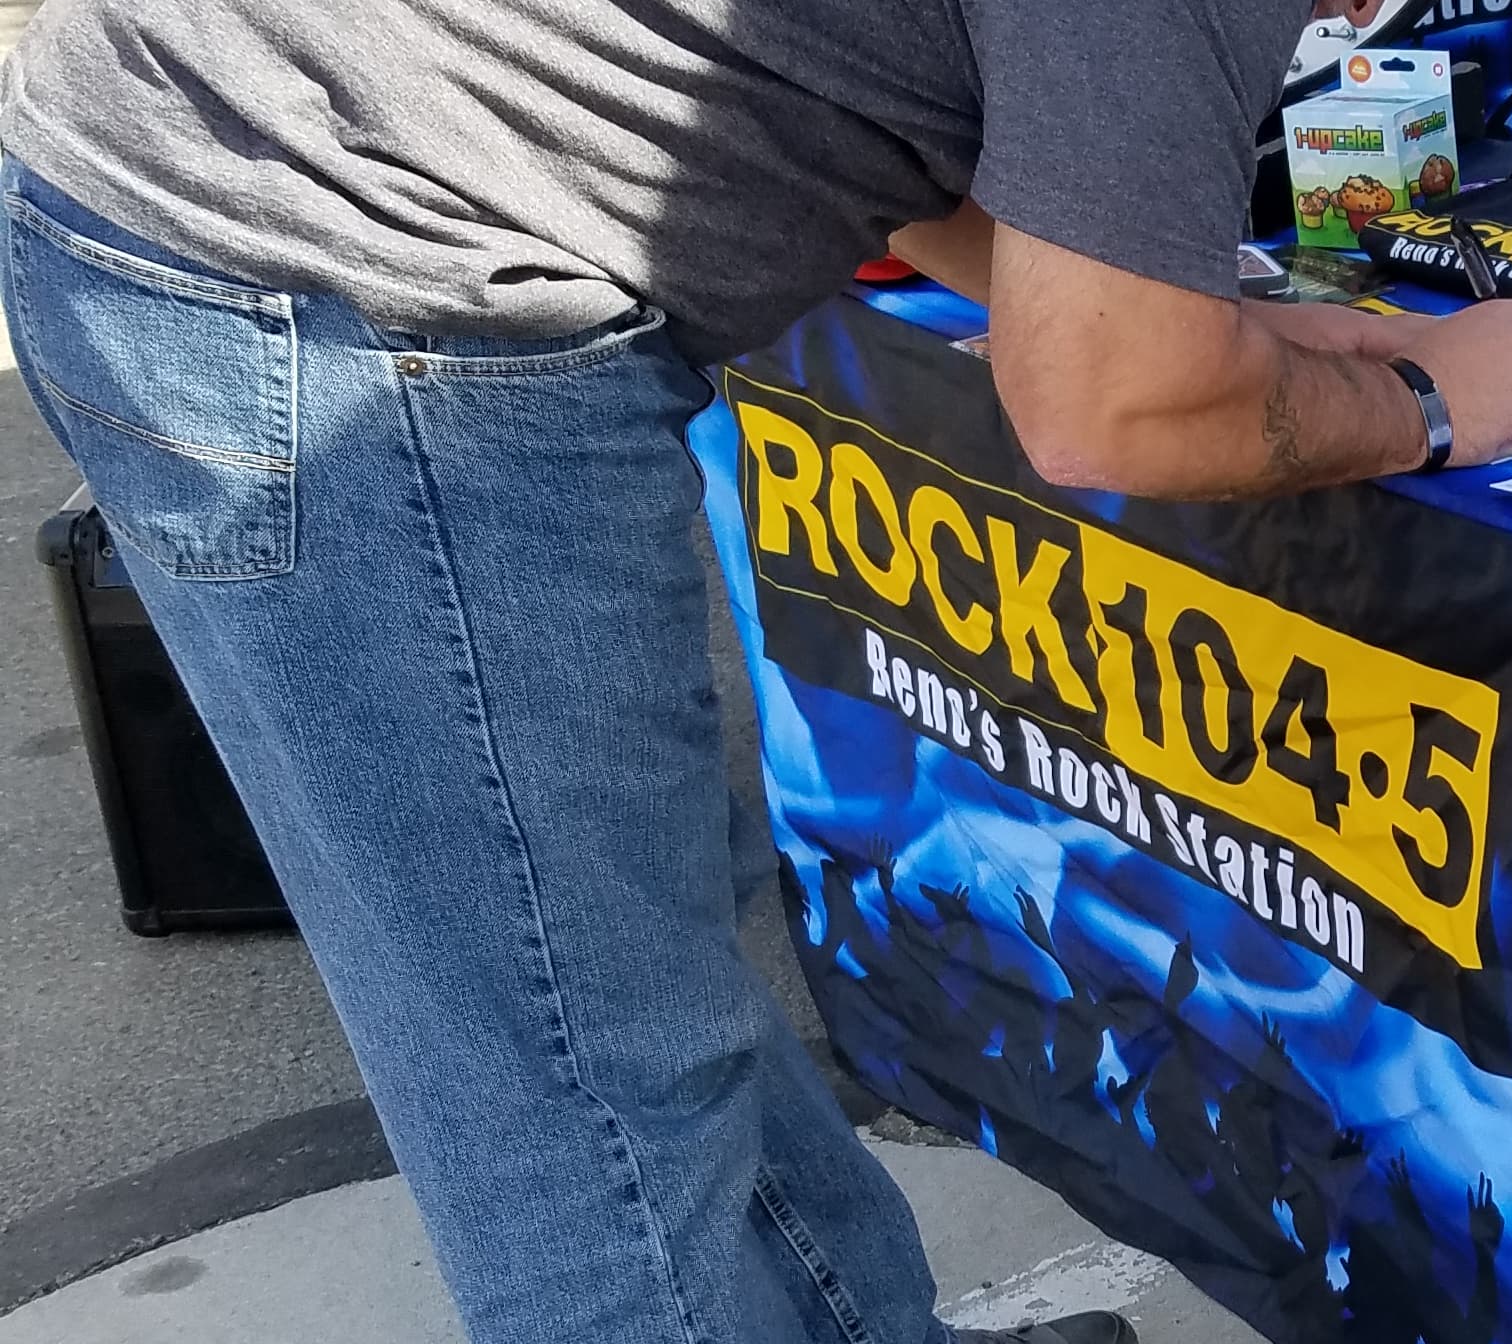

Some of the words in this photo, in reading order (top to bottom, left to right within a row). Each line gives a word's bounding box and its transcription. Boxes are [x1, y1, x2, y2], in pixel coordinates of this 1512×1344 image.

[1389, 236, 1456, 268] Reno's
[737, 401, 1098, 714] ROCK
[865, 628, 1006, 773] Reno's
[1017, 714, 1152, 844] Rock
[1155, 789, 1367, 975] Station
